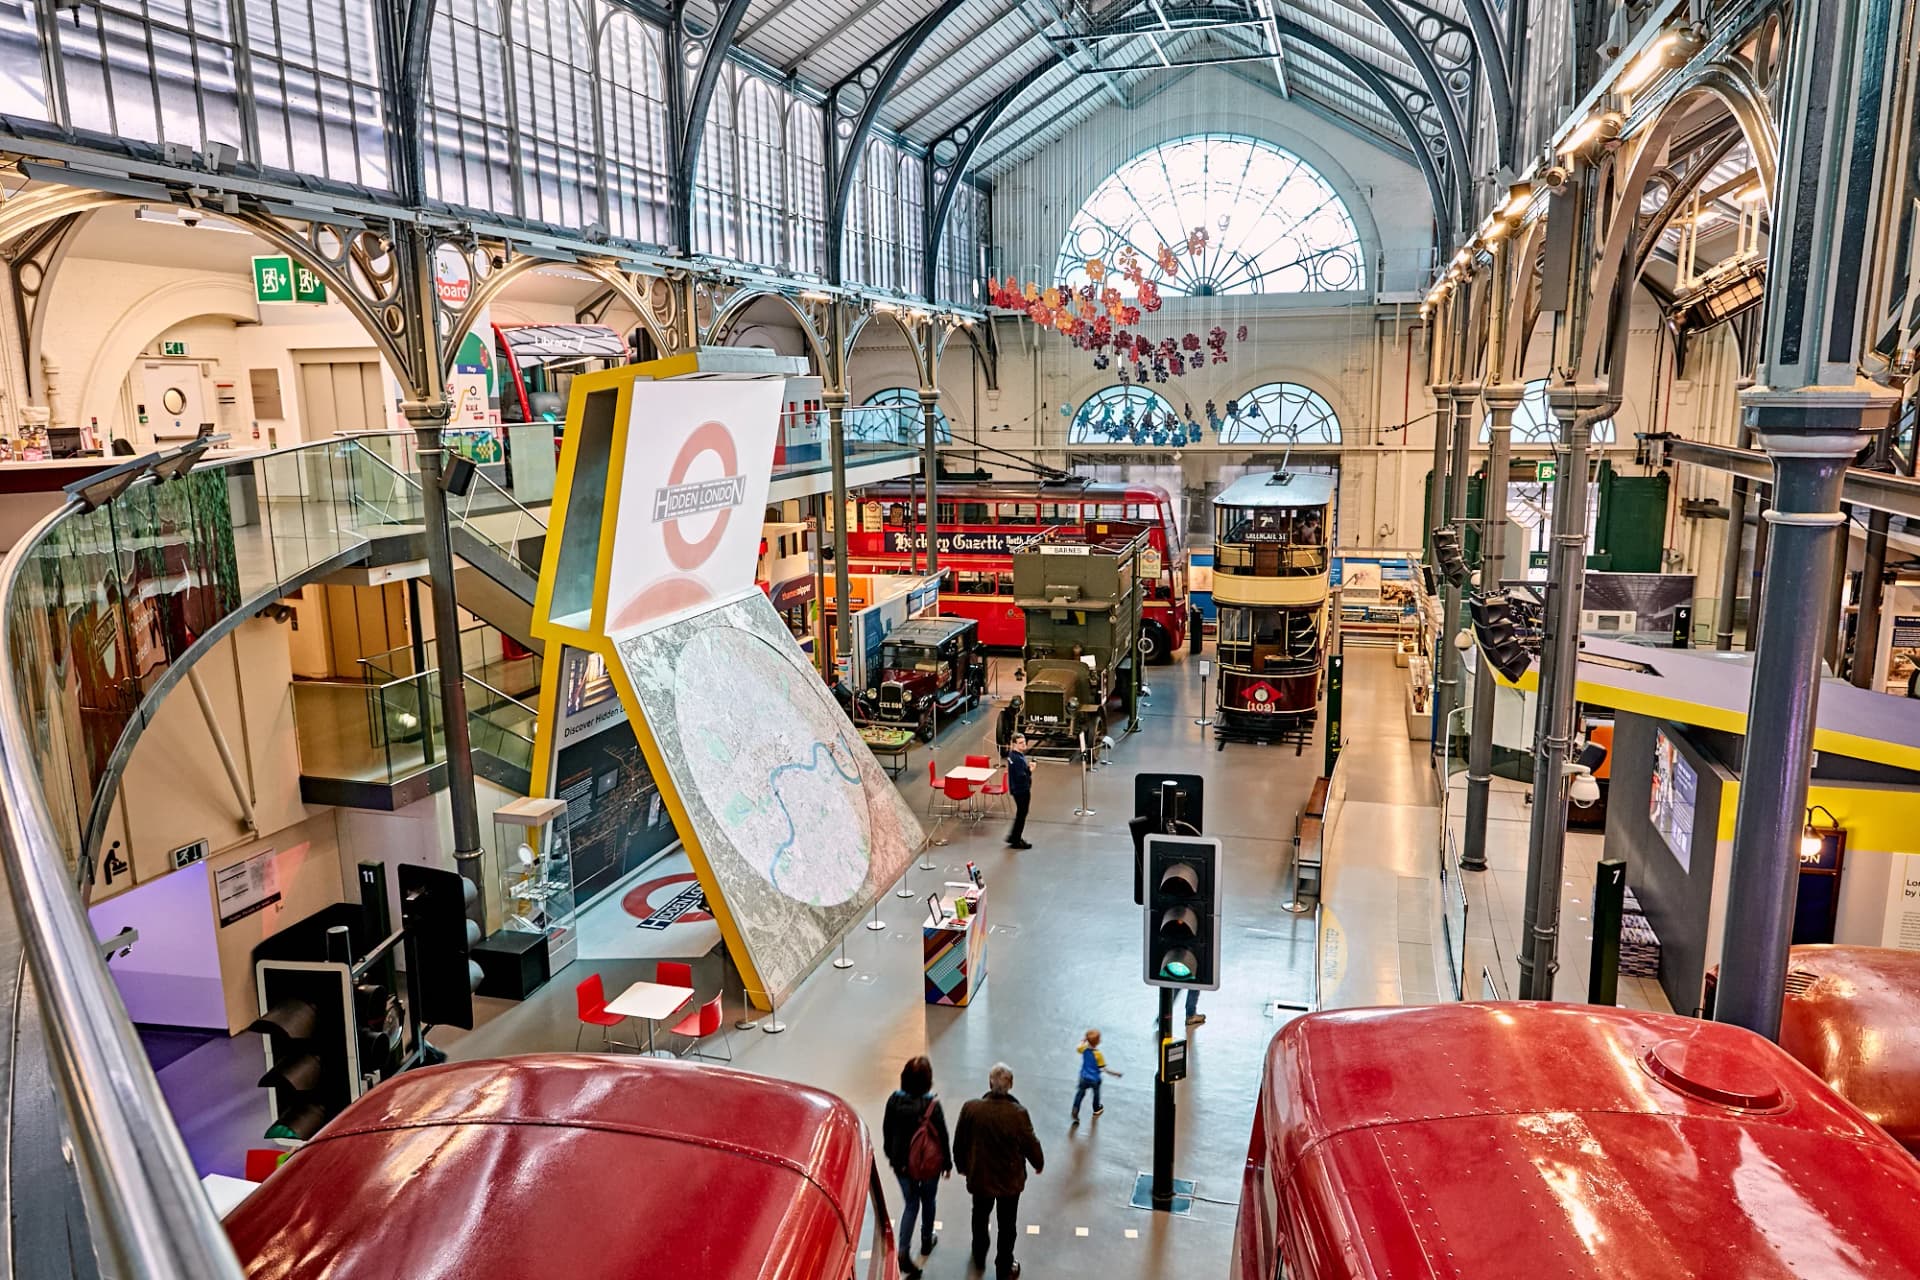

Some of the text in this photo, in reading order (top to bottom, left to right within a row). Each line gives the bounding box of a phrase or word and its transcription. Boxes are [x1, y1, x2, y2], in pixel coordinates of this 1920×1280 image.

[654, 477, 745, 520] HIDDEN LONDON
[953, 533, 1004, 551] Gazette
[1679, 609, 1687, 619] 6
[1334, 658, 1342, 668] 9
[564, 717, 595, 738] Discover
[595, 707, 619, 725] Hidden
[362, 870, 375, 884] 11
[640, 897, 693, 930] HIDDEN
